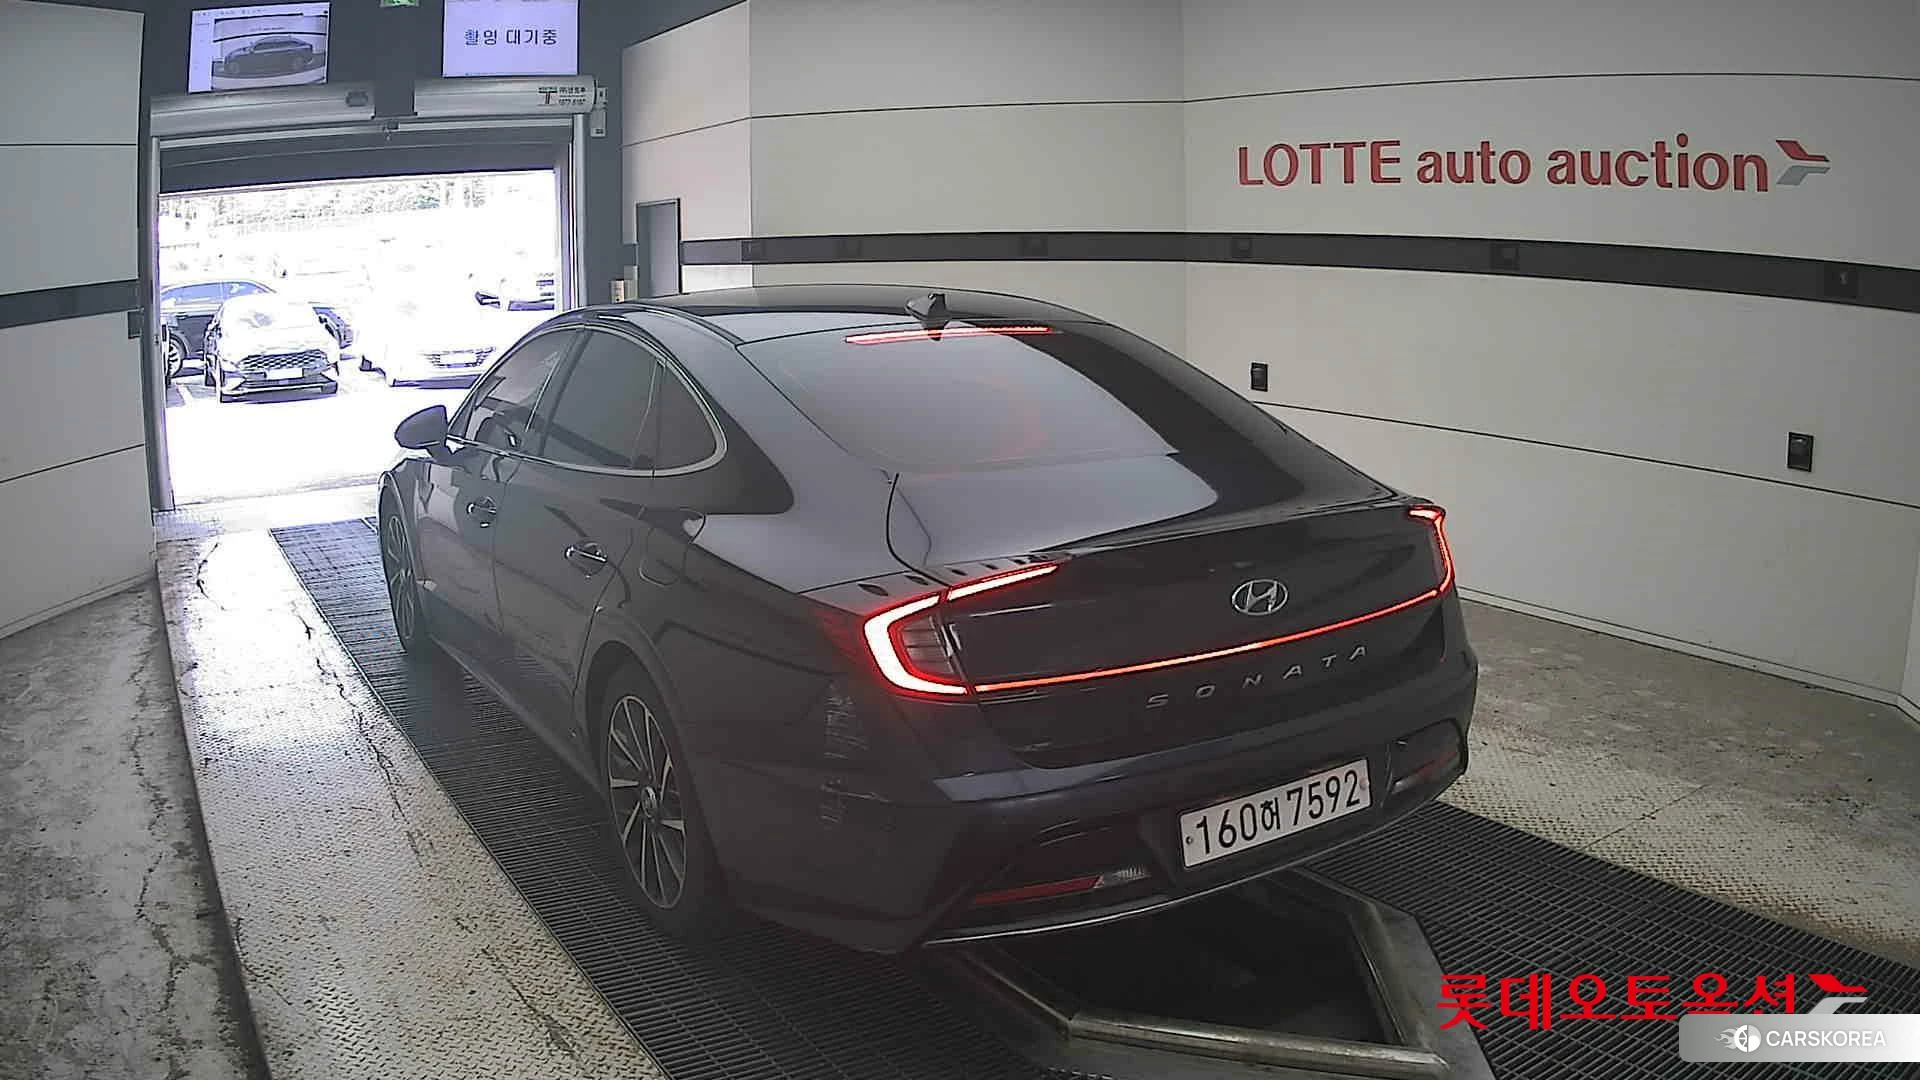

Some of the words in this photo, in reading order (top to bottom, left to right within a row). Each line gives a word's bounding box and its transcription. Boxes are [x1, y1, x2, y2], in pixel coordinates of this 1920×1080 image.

[505, 28, 558, 46] 대기중
[1239, 140, 1402, 187] LOTTE
[1417, 141, 1531, 186] auto
[1547, 133, 1768, 192] auction
[1145, 645, 1367, 709] SONATA
